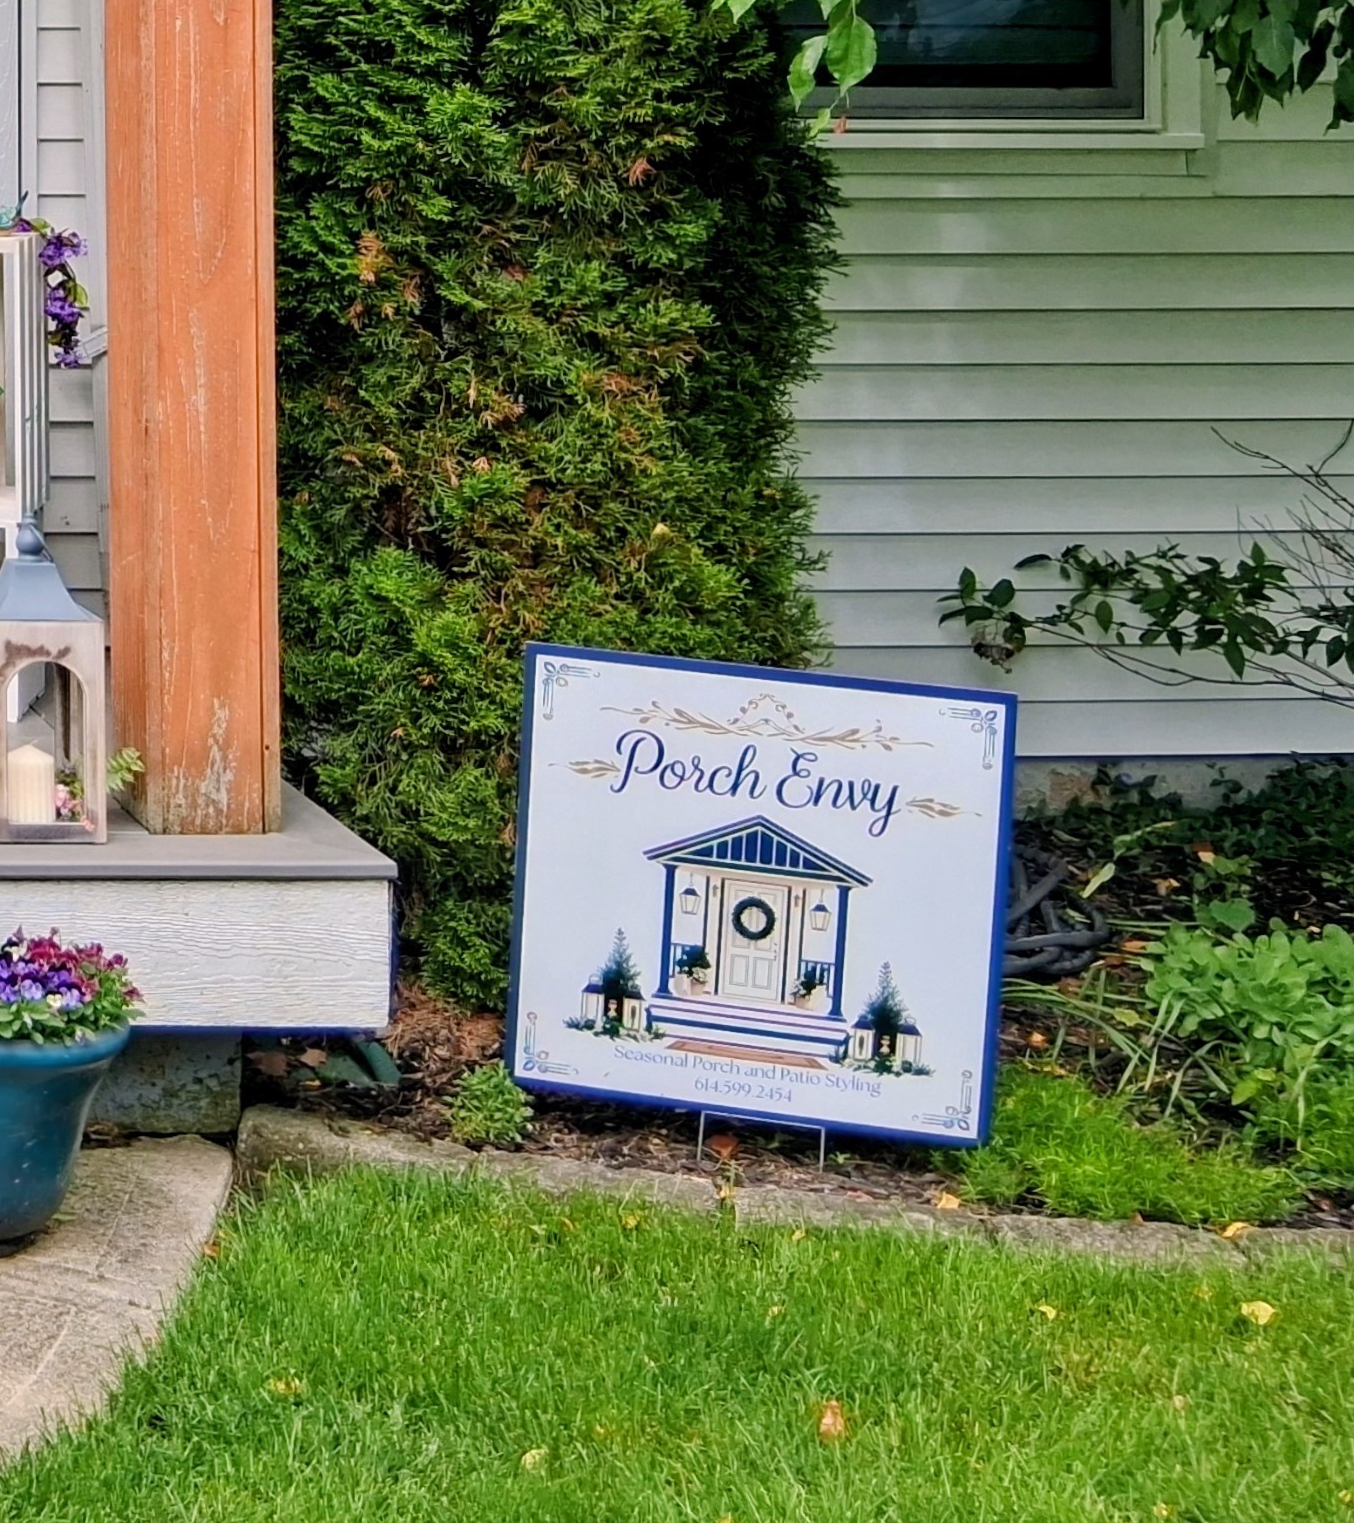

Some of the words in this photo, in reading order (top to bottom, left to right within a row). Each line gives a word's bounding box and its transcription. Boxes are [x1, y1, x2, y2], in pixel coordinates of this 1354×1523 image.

[609, 728, 767, 800] Porch
[775, 746, 902, 838] Envy
[613, 1044, 689, 1068] Seasonal
[692, 1054, 741, 1076] Porch
[744, 1065, 777, 1081] and
[780, 1068, 821, 1086] Patio
[824, 1073, 882, 1098] Styling
[694, 1075, 793, 1104] 614.599.2454
